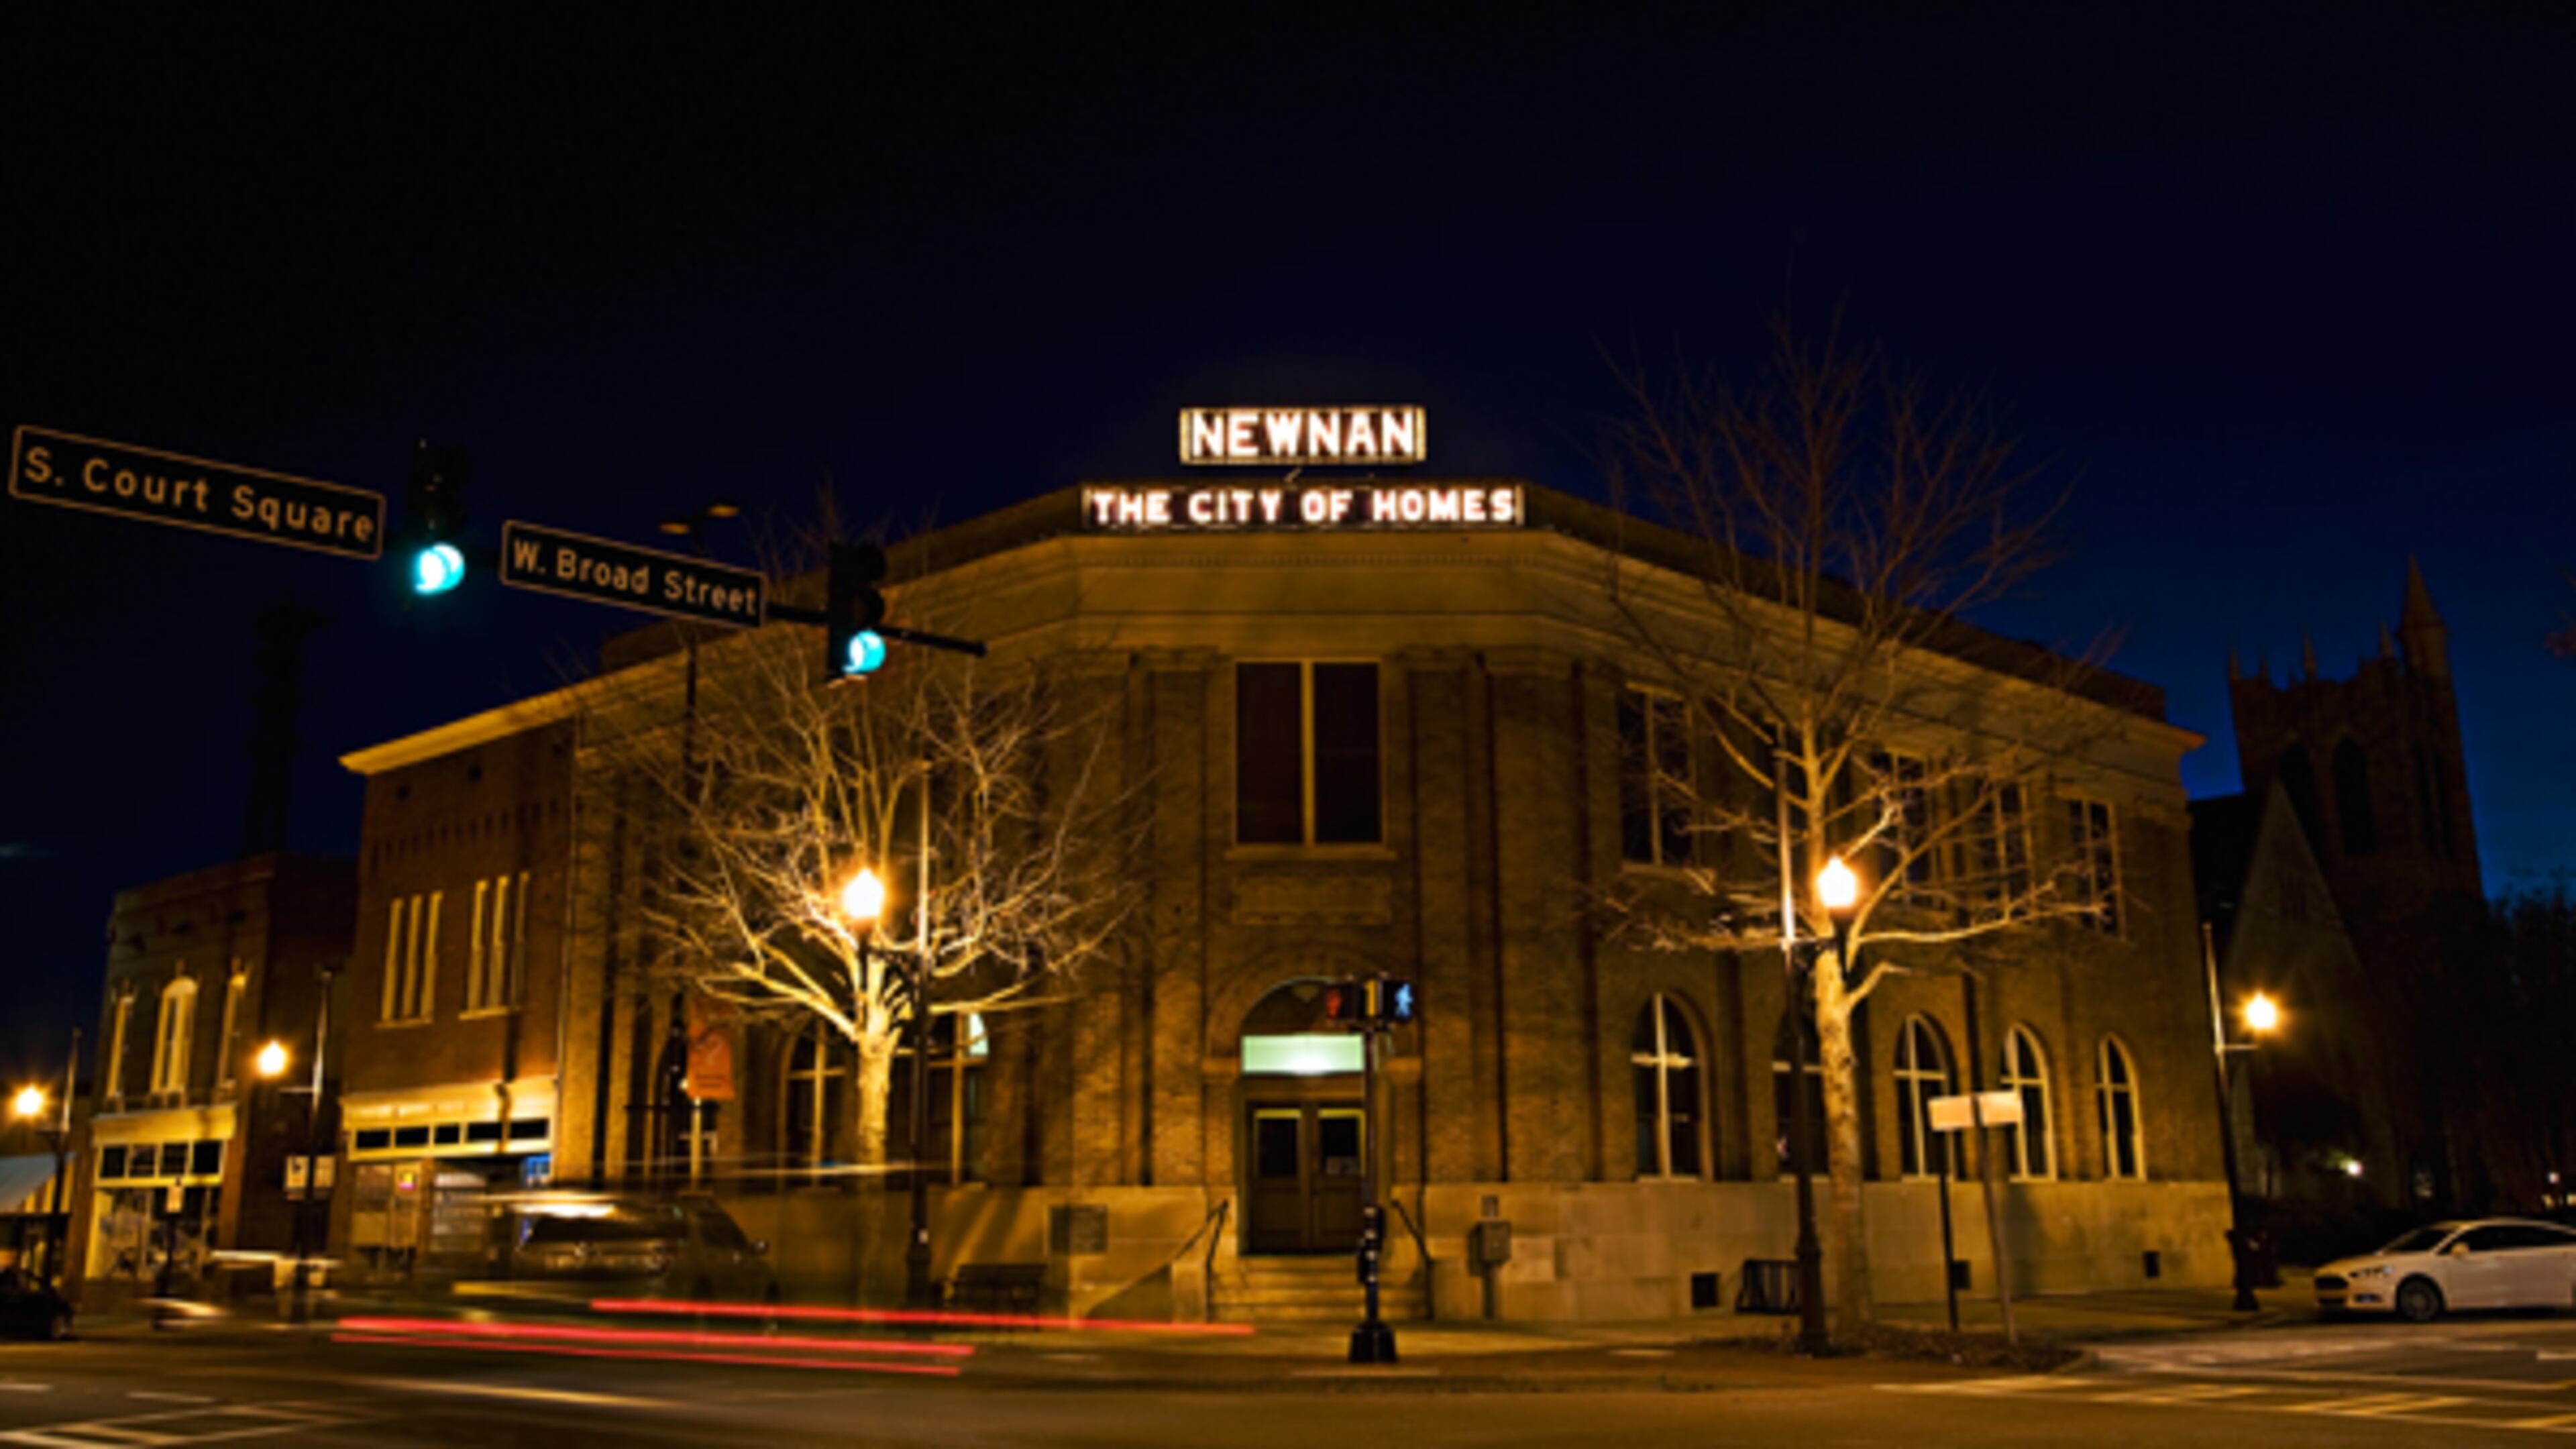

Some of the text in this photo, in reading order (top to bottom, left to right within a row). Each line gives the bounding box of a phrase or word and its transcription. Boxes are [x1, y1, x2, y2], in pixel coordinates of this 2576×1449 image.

[1192, 411, 1414, 458] NEWNAN
[23, 444, 376, 543] S. Court Square
[1093, 489, 1514, 524] THE CITY OF HOMES
[513, 538, 757, 616] W. Broad Street
